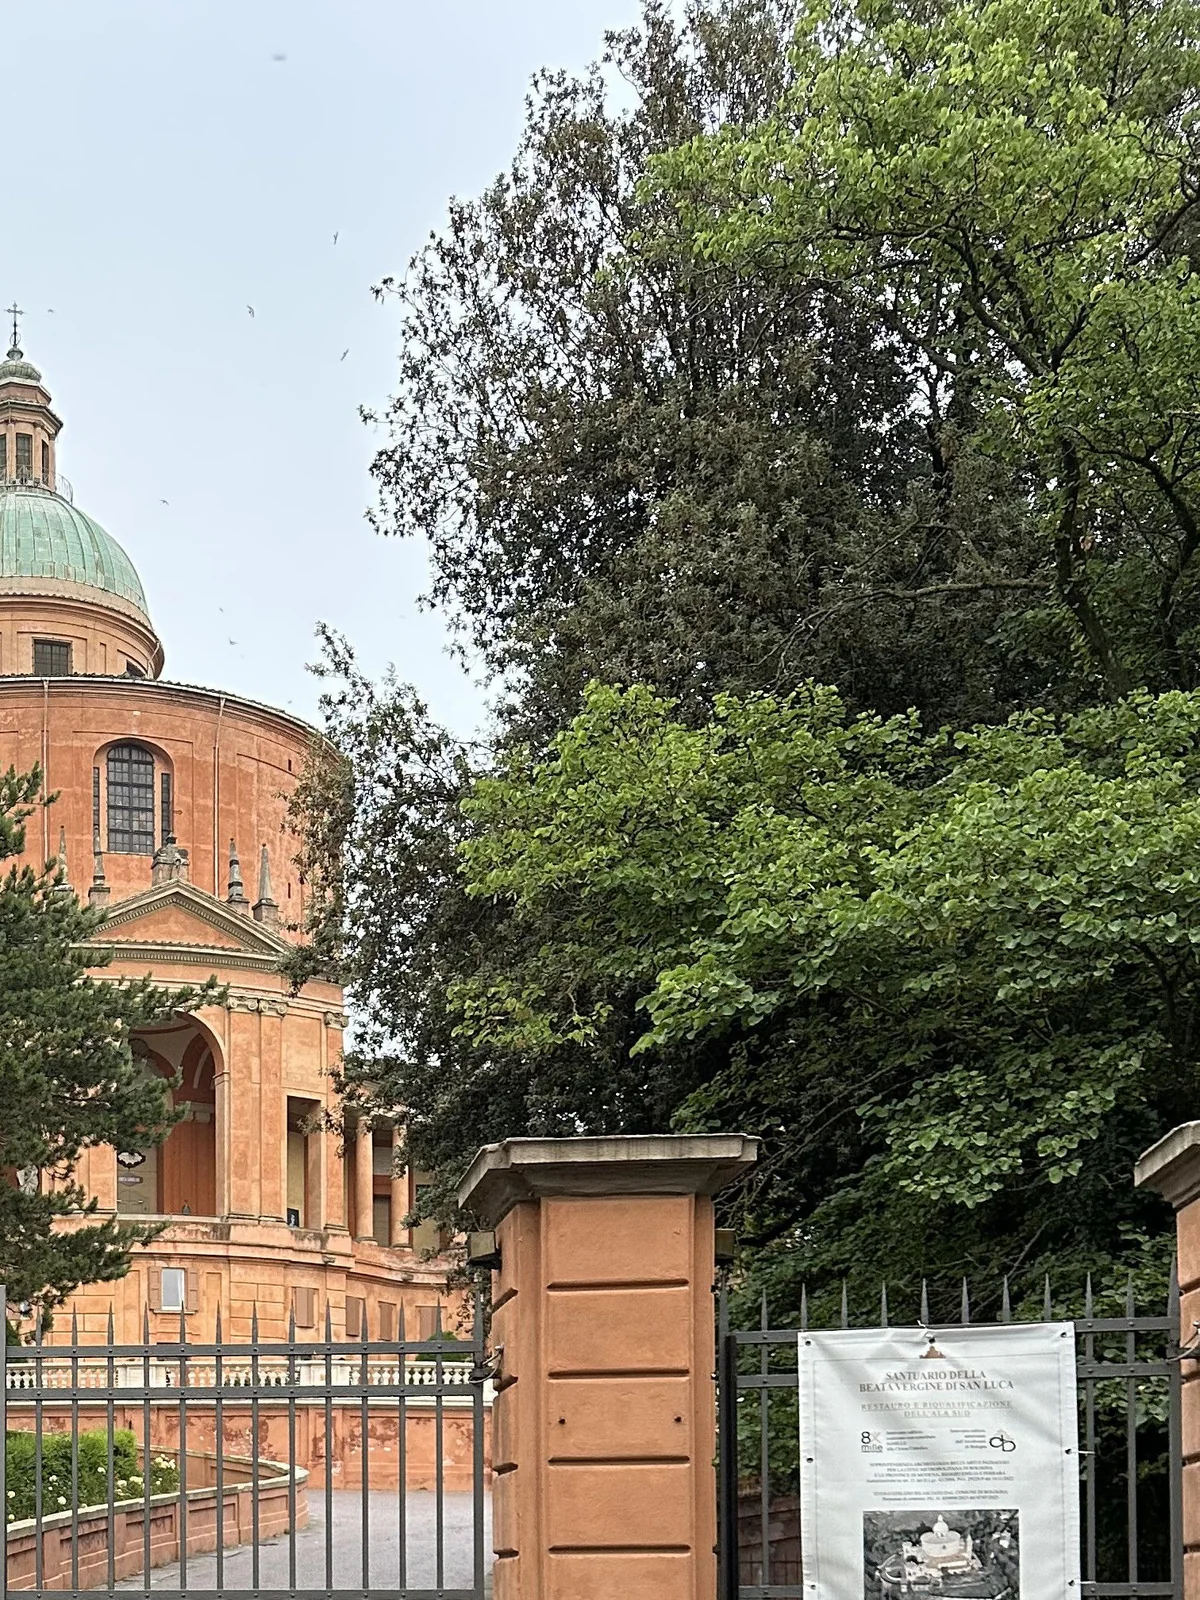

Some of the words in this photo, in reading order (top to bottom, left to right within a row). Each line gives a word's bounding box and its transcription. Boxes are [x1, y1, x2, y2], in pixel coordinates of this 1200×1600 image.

[886, 1371, 947, 1381] SANTUARIO
[949, 1370, 987, 1380] DELLA
[859, 1382, 894, 1393] BEATA
[894, 1381, 943, 1392] VERGINE
[945, 1381, 957, 1391] DI
[959, 1380, 984, 1390] SAN
[984, 1380, 1014, 1390] LUCA
[861, 1401, 911, 1411] RESTAURO
